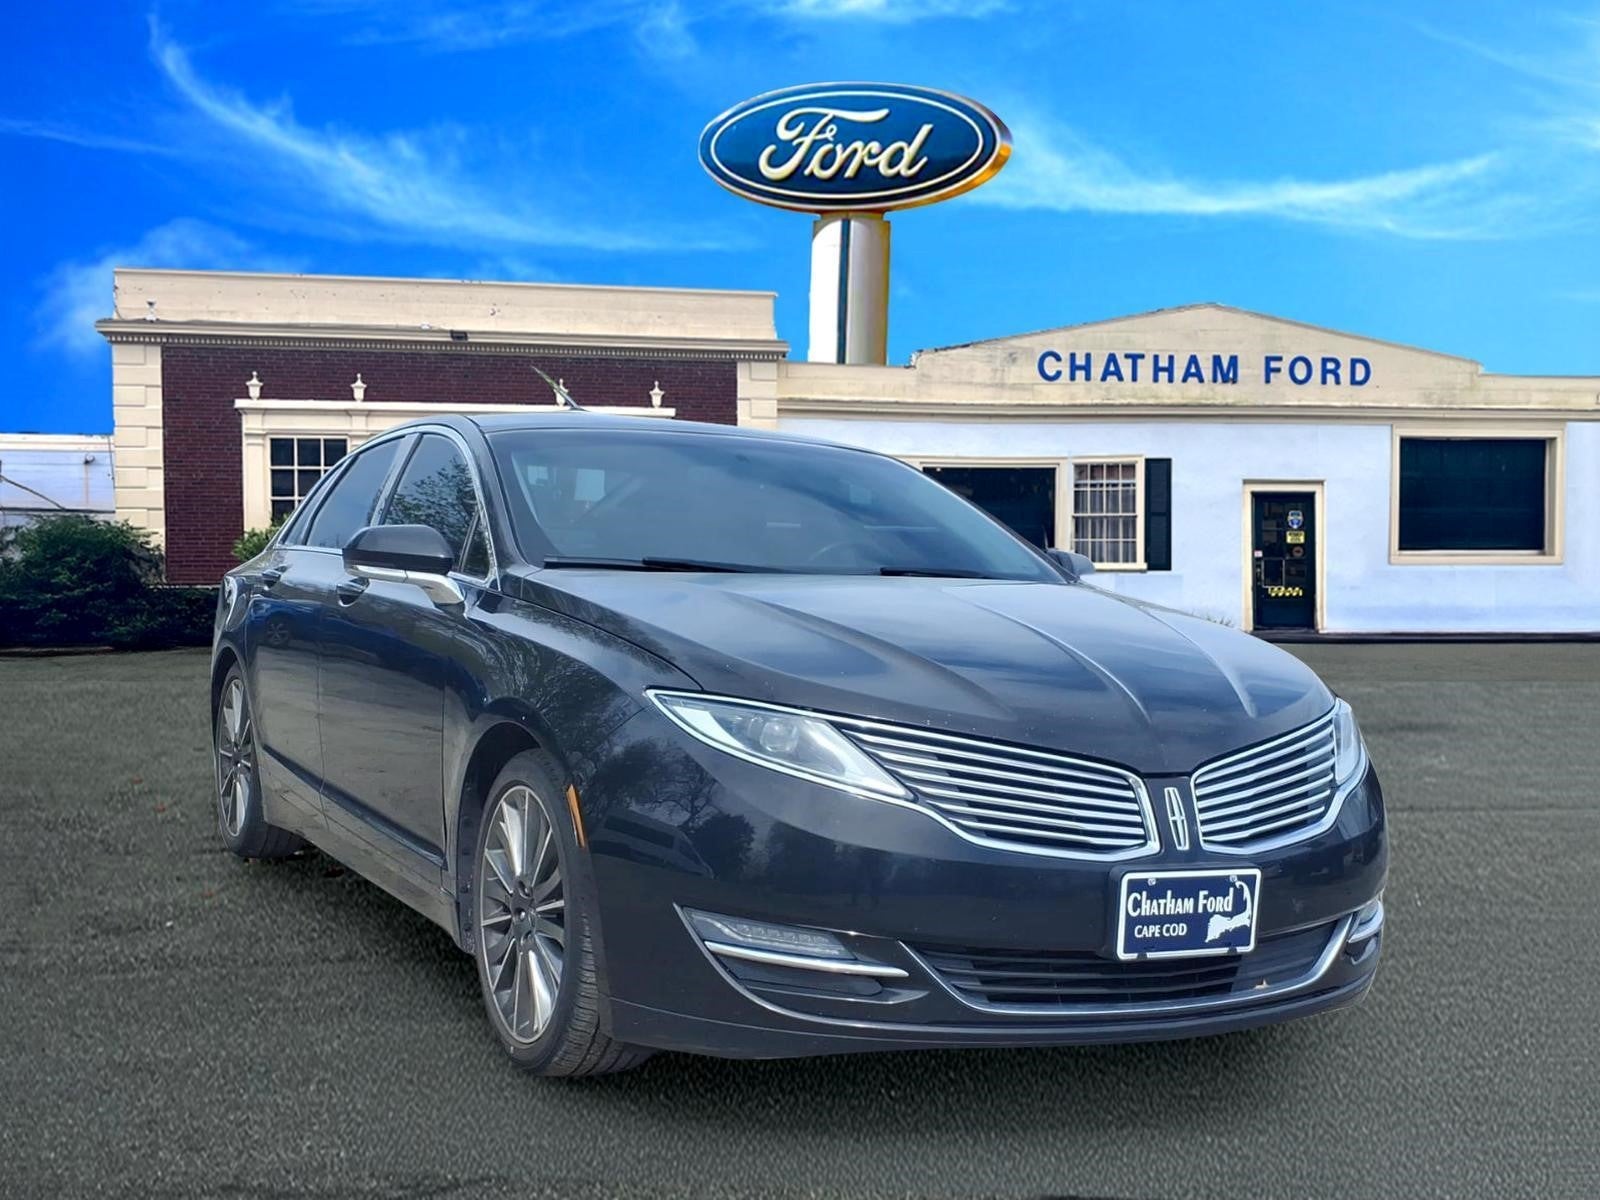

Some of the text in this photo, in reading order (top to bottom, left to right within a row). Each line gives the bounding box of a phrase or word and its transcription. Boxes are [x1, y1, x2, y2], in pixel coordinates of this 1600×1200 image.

[758, 107, 934, 181] Ford
[1037, 350, 1372, 386] CHATHAM FORD
[1134, 923, 1187, 938] CAPE COD
